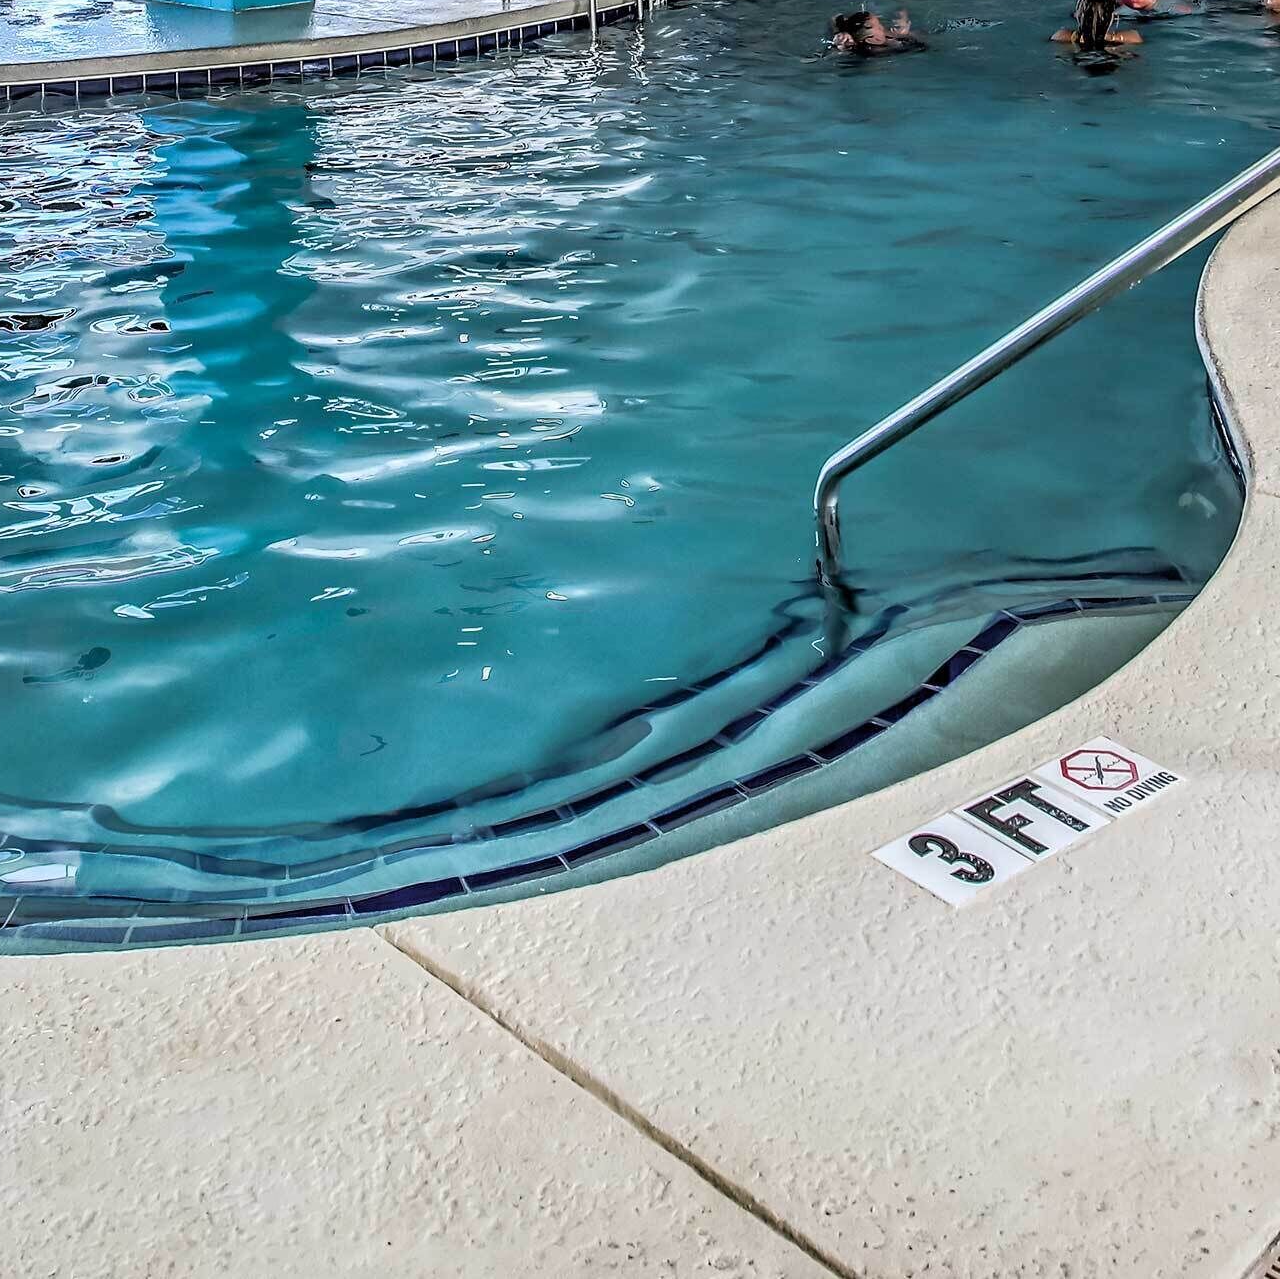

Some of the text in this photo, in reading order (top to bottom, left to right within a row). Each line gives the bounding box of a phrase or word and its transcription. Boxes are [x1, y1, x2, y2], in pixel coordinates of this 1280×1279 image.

[1103, 771, 1179, 813] NO DIVING
[907, 778, 1092, 884] 3 FT
